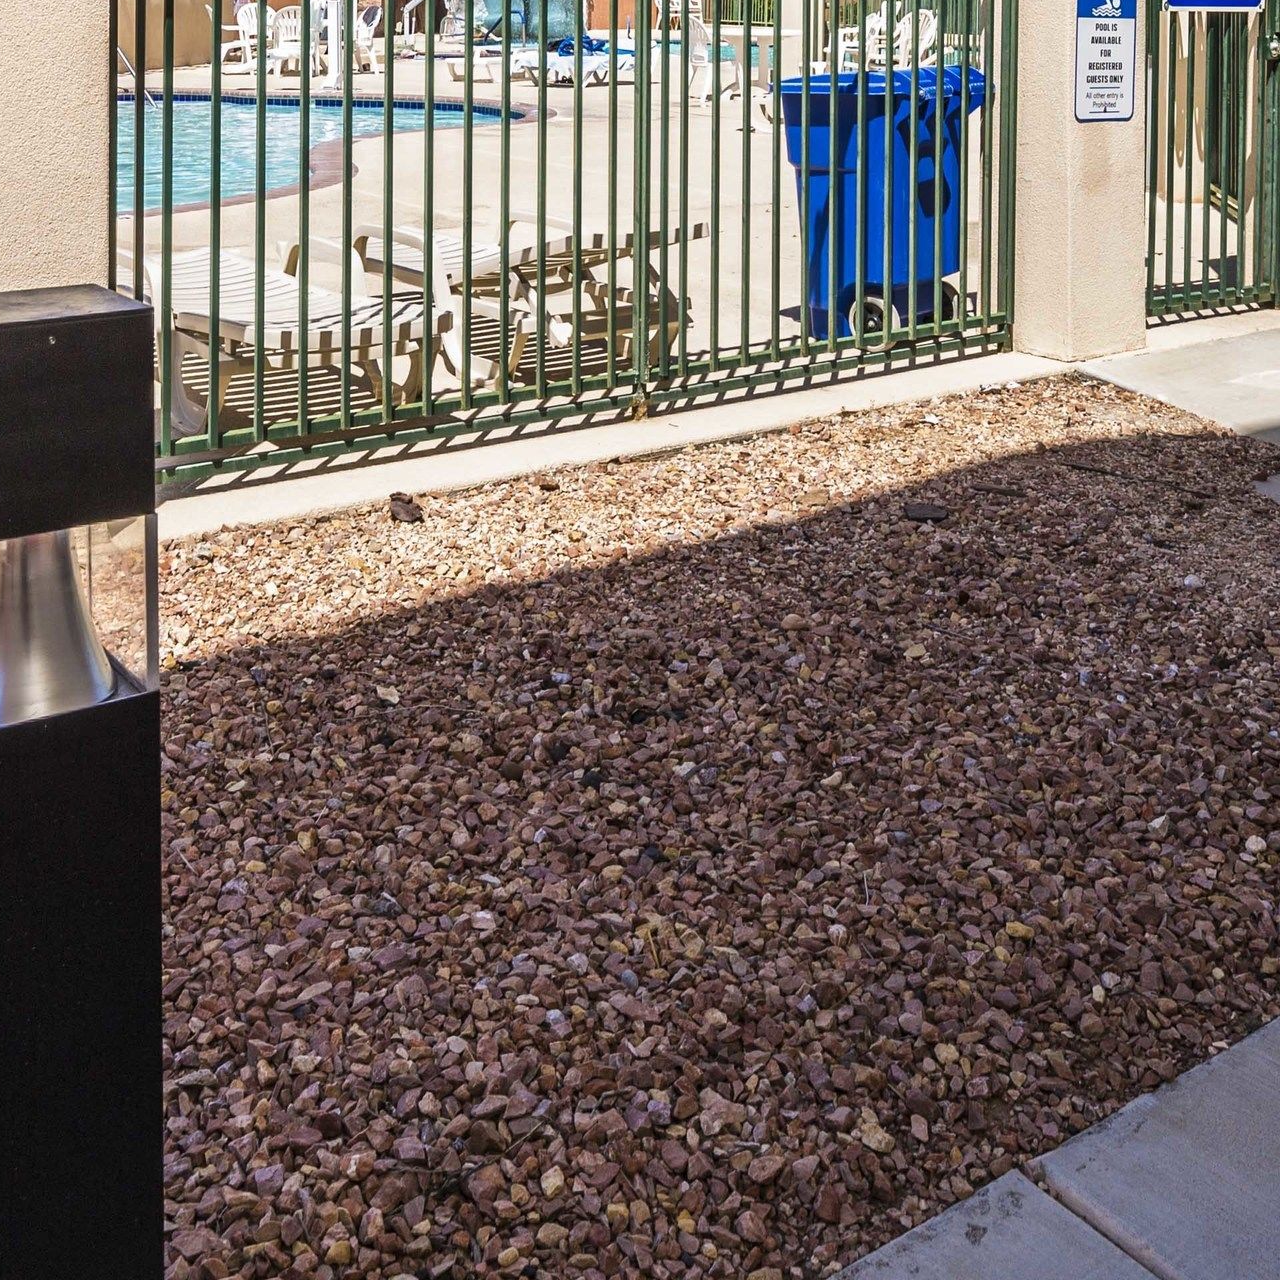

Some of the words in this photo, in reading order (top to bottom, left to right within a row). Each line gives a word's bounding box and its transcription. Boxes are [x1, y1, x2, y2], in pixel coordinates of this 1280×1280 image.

[1095, 23, 1110, 31] POOL
[1111, 23, 1118, 32] IS
[1091, 36, 1121, 45] AVAILABLE
[1100, 49, 1111, 57] FOR
[1088, 62, 1122, 70] REGISTERED
[1086, 75, 1108, 83] GUESTS
[1109, 75, 1124, 83] ONLY
[1106, 92, 1118, 100] entry
